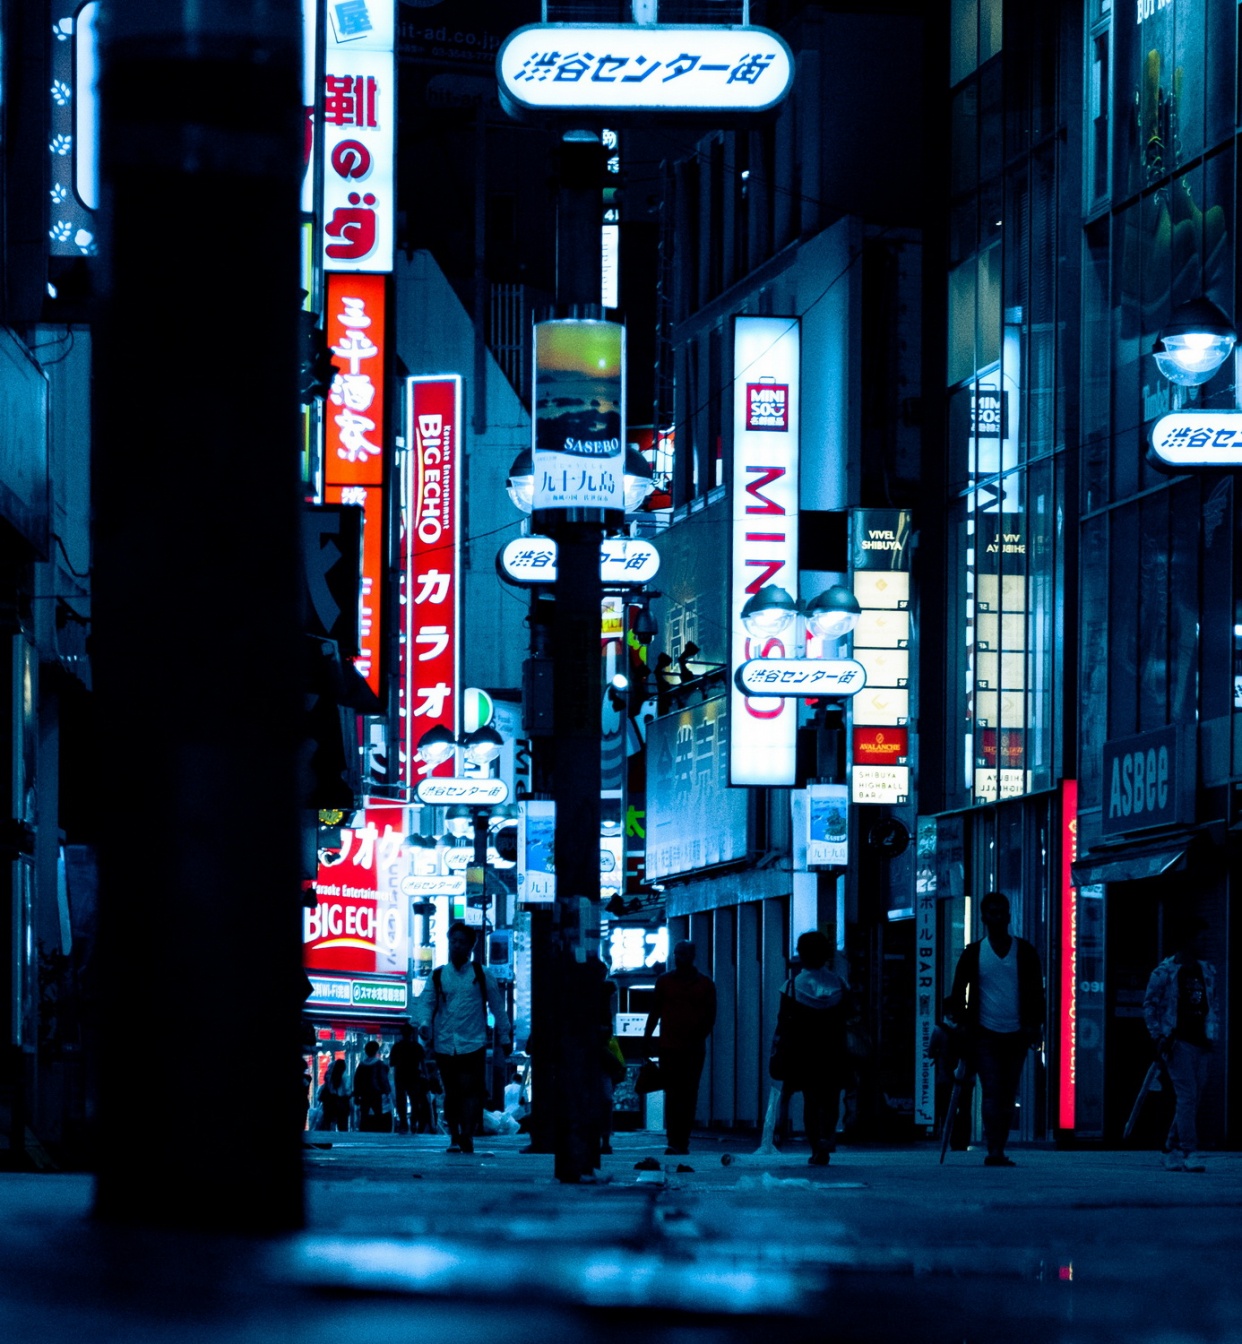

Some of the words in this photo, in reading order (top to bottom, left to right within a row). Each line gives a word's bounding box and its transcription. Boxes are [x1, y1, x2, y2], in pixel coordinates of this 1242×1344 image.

[514, 51, 776, 84] 渋谷センター街
[750, 389, 785, 402] MINI
[418, 414, 443, 465] BIG
[443, 425, 451, 461] Karaoke
[564, 437, 619, 454] SASEBO
[443, 464, 451, 530] Entertainment
[541, 470, 616, 495] 九十九島
[418, 469, 443, 544] ECHO
[861, 541, 903, 550] SHIBUYA
[868, 530, 895, 540] VIVEL
[747, 669, 858, 684] 渋谷センター街
[422, 782, 504, 797] 渋谷センター街
[304, 902, 343, 943] BIG
[345, 906, 401, 949] ECHO
[919, 948, 932, 987] BAR
